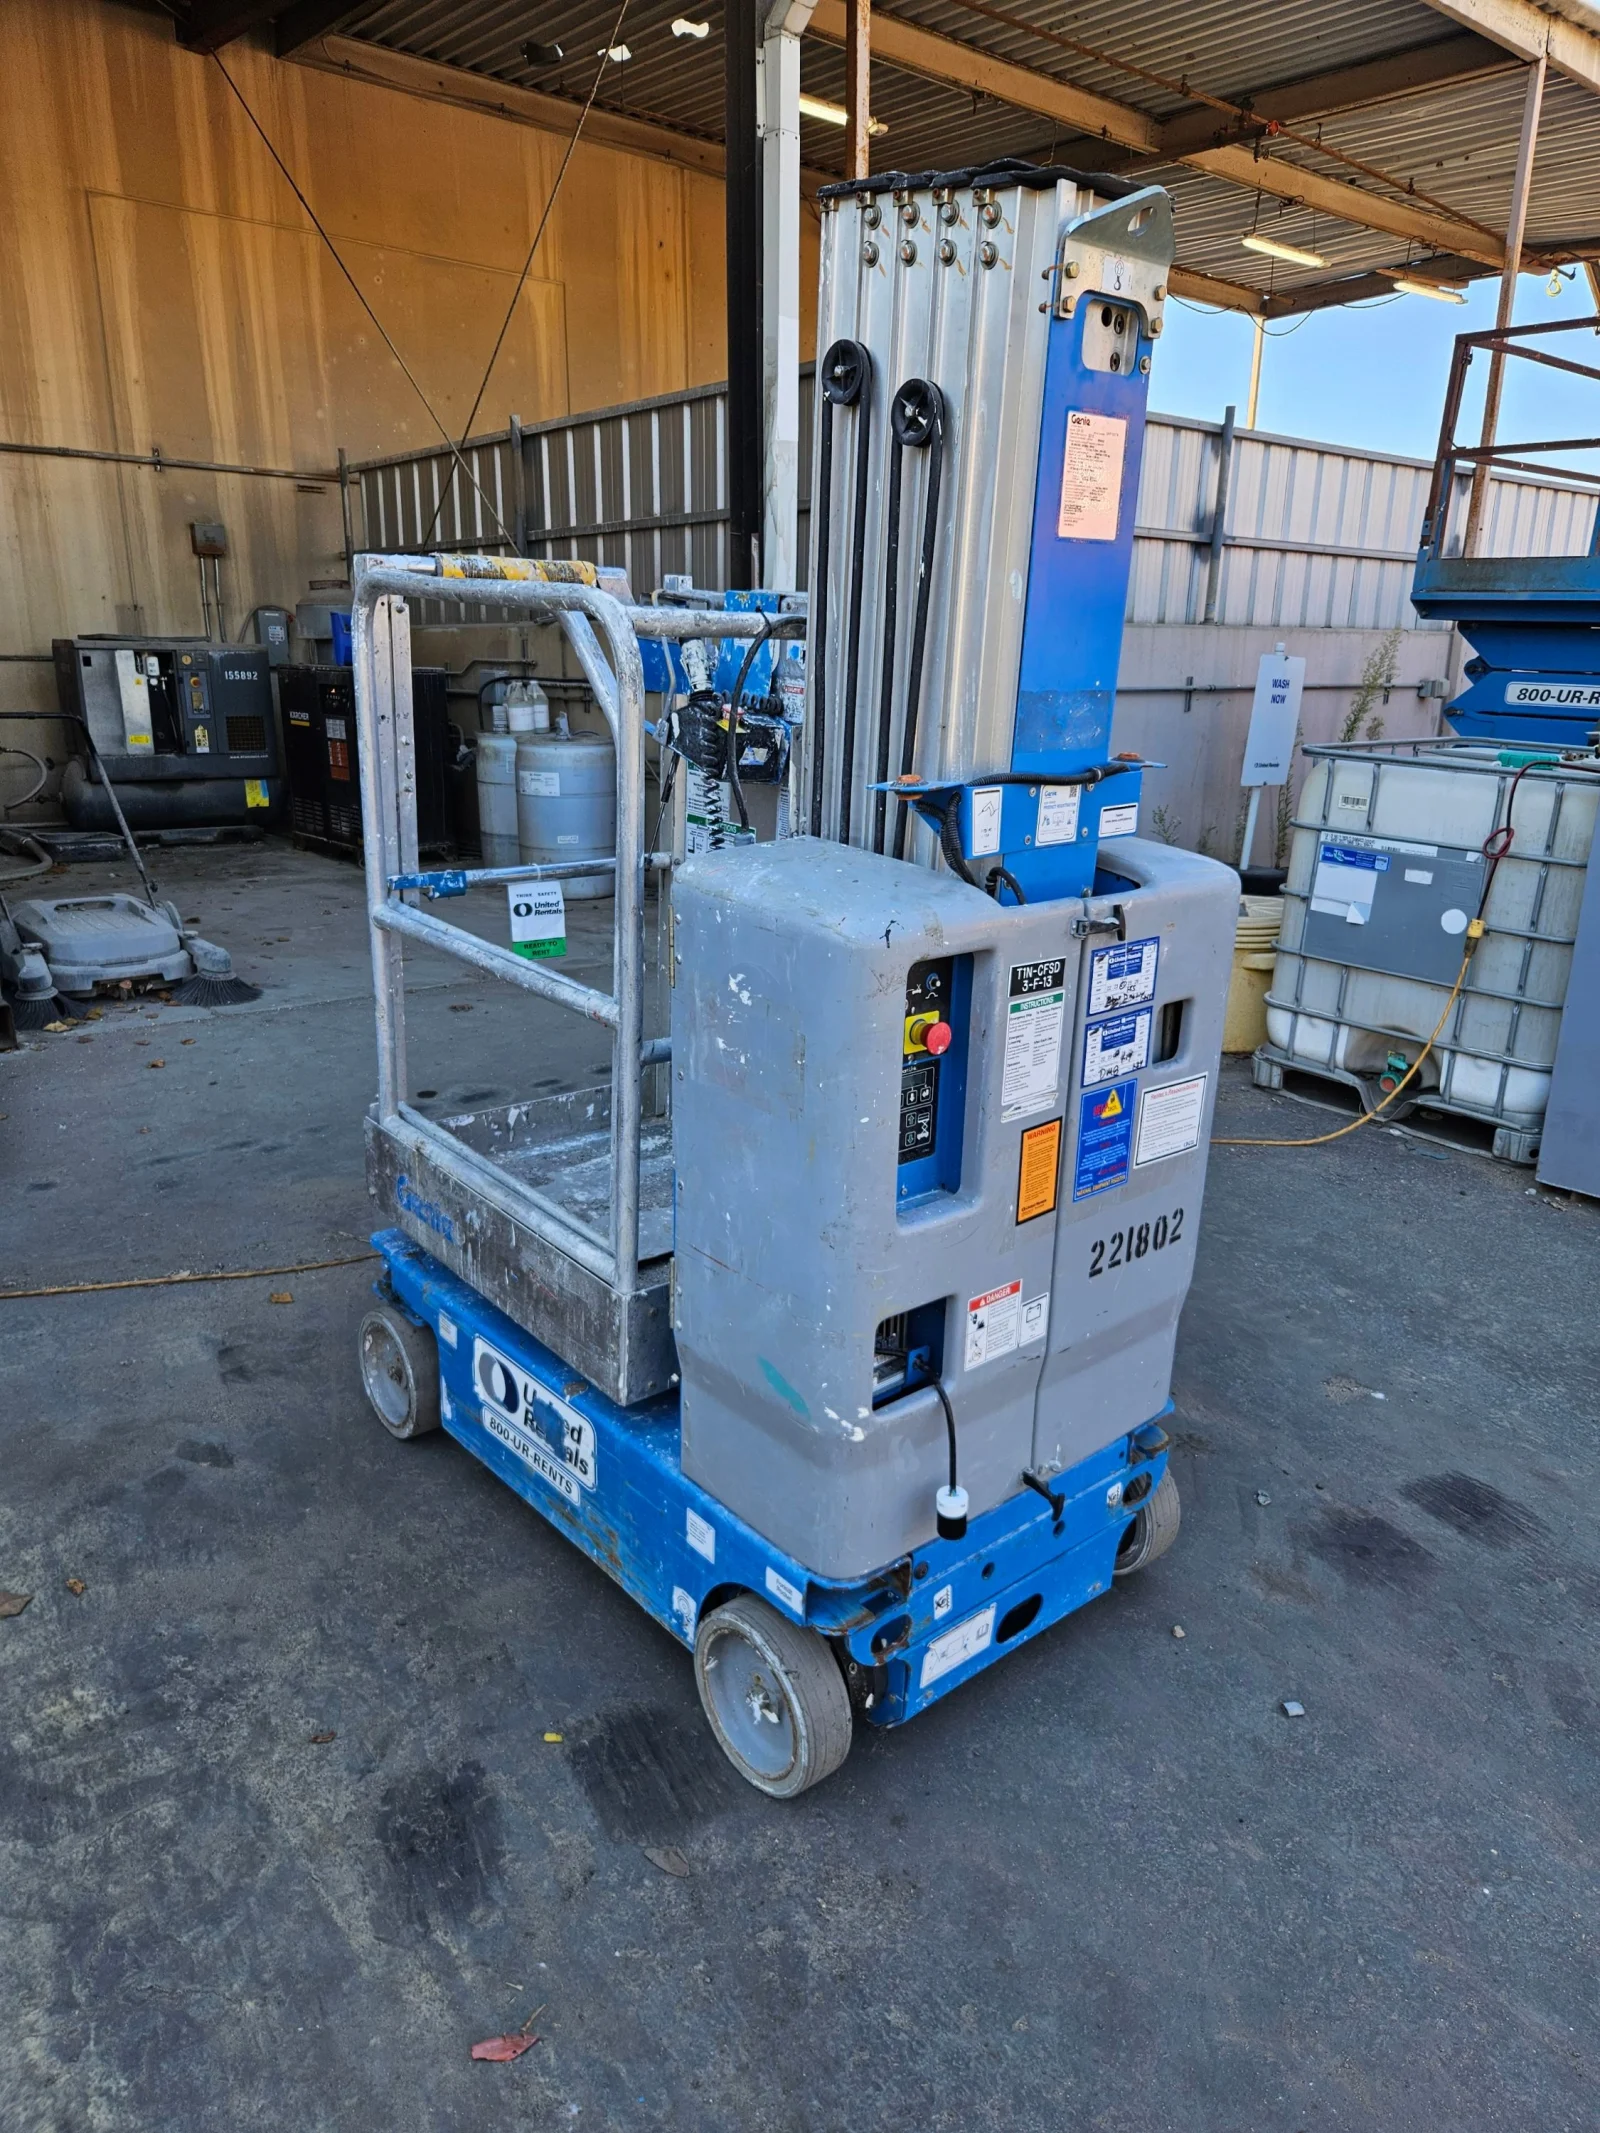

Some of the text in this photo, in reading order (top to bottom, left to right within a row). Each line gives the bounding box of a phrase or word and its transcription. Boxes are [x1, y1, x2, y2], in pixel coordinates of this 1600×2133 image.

[1071, 414, 1091, 426] Genie
[224, 671, 258, 680] 155892
[1272, 679, 1290, 689] WASH
[1270, 694, 1287, 704] NOW
[534, 901, 560, 909] United
[534, 908, 563, 916] Rentals
[1016, 961, 1061, 980] T1N-CFSD
[1021, 975, 1053, 992] 3-F-13
[1020, 996, 1054, 1011] INSTRUCTIONS
[1027, 1124, 1056, 1140] WARNING
[396, 1175, 454, 1244] Genie
[1089, 1207, 1184, 1278] 221802
[986, 1287, 1011, 1303] DANGER
[523, 1382, 583, 1445] Ued
[489, 1416, 573, 1495] 800-UR-RENTS
